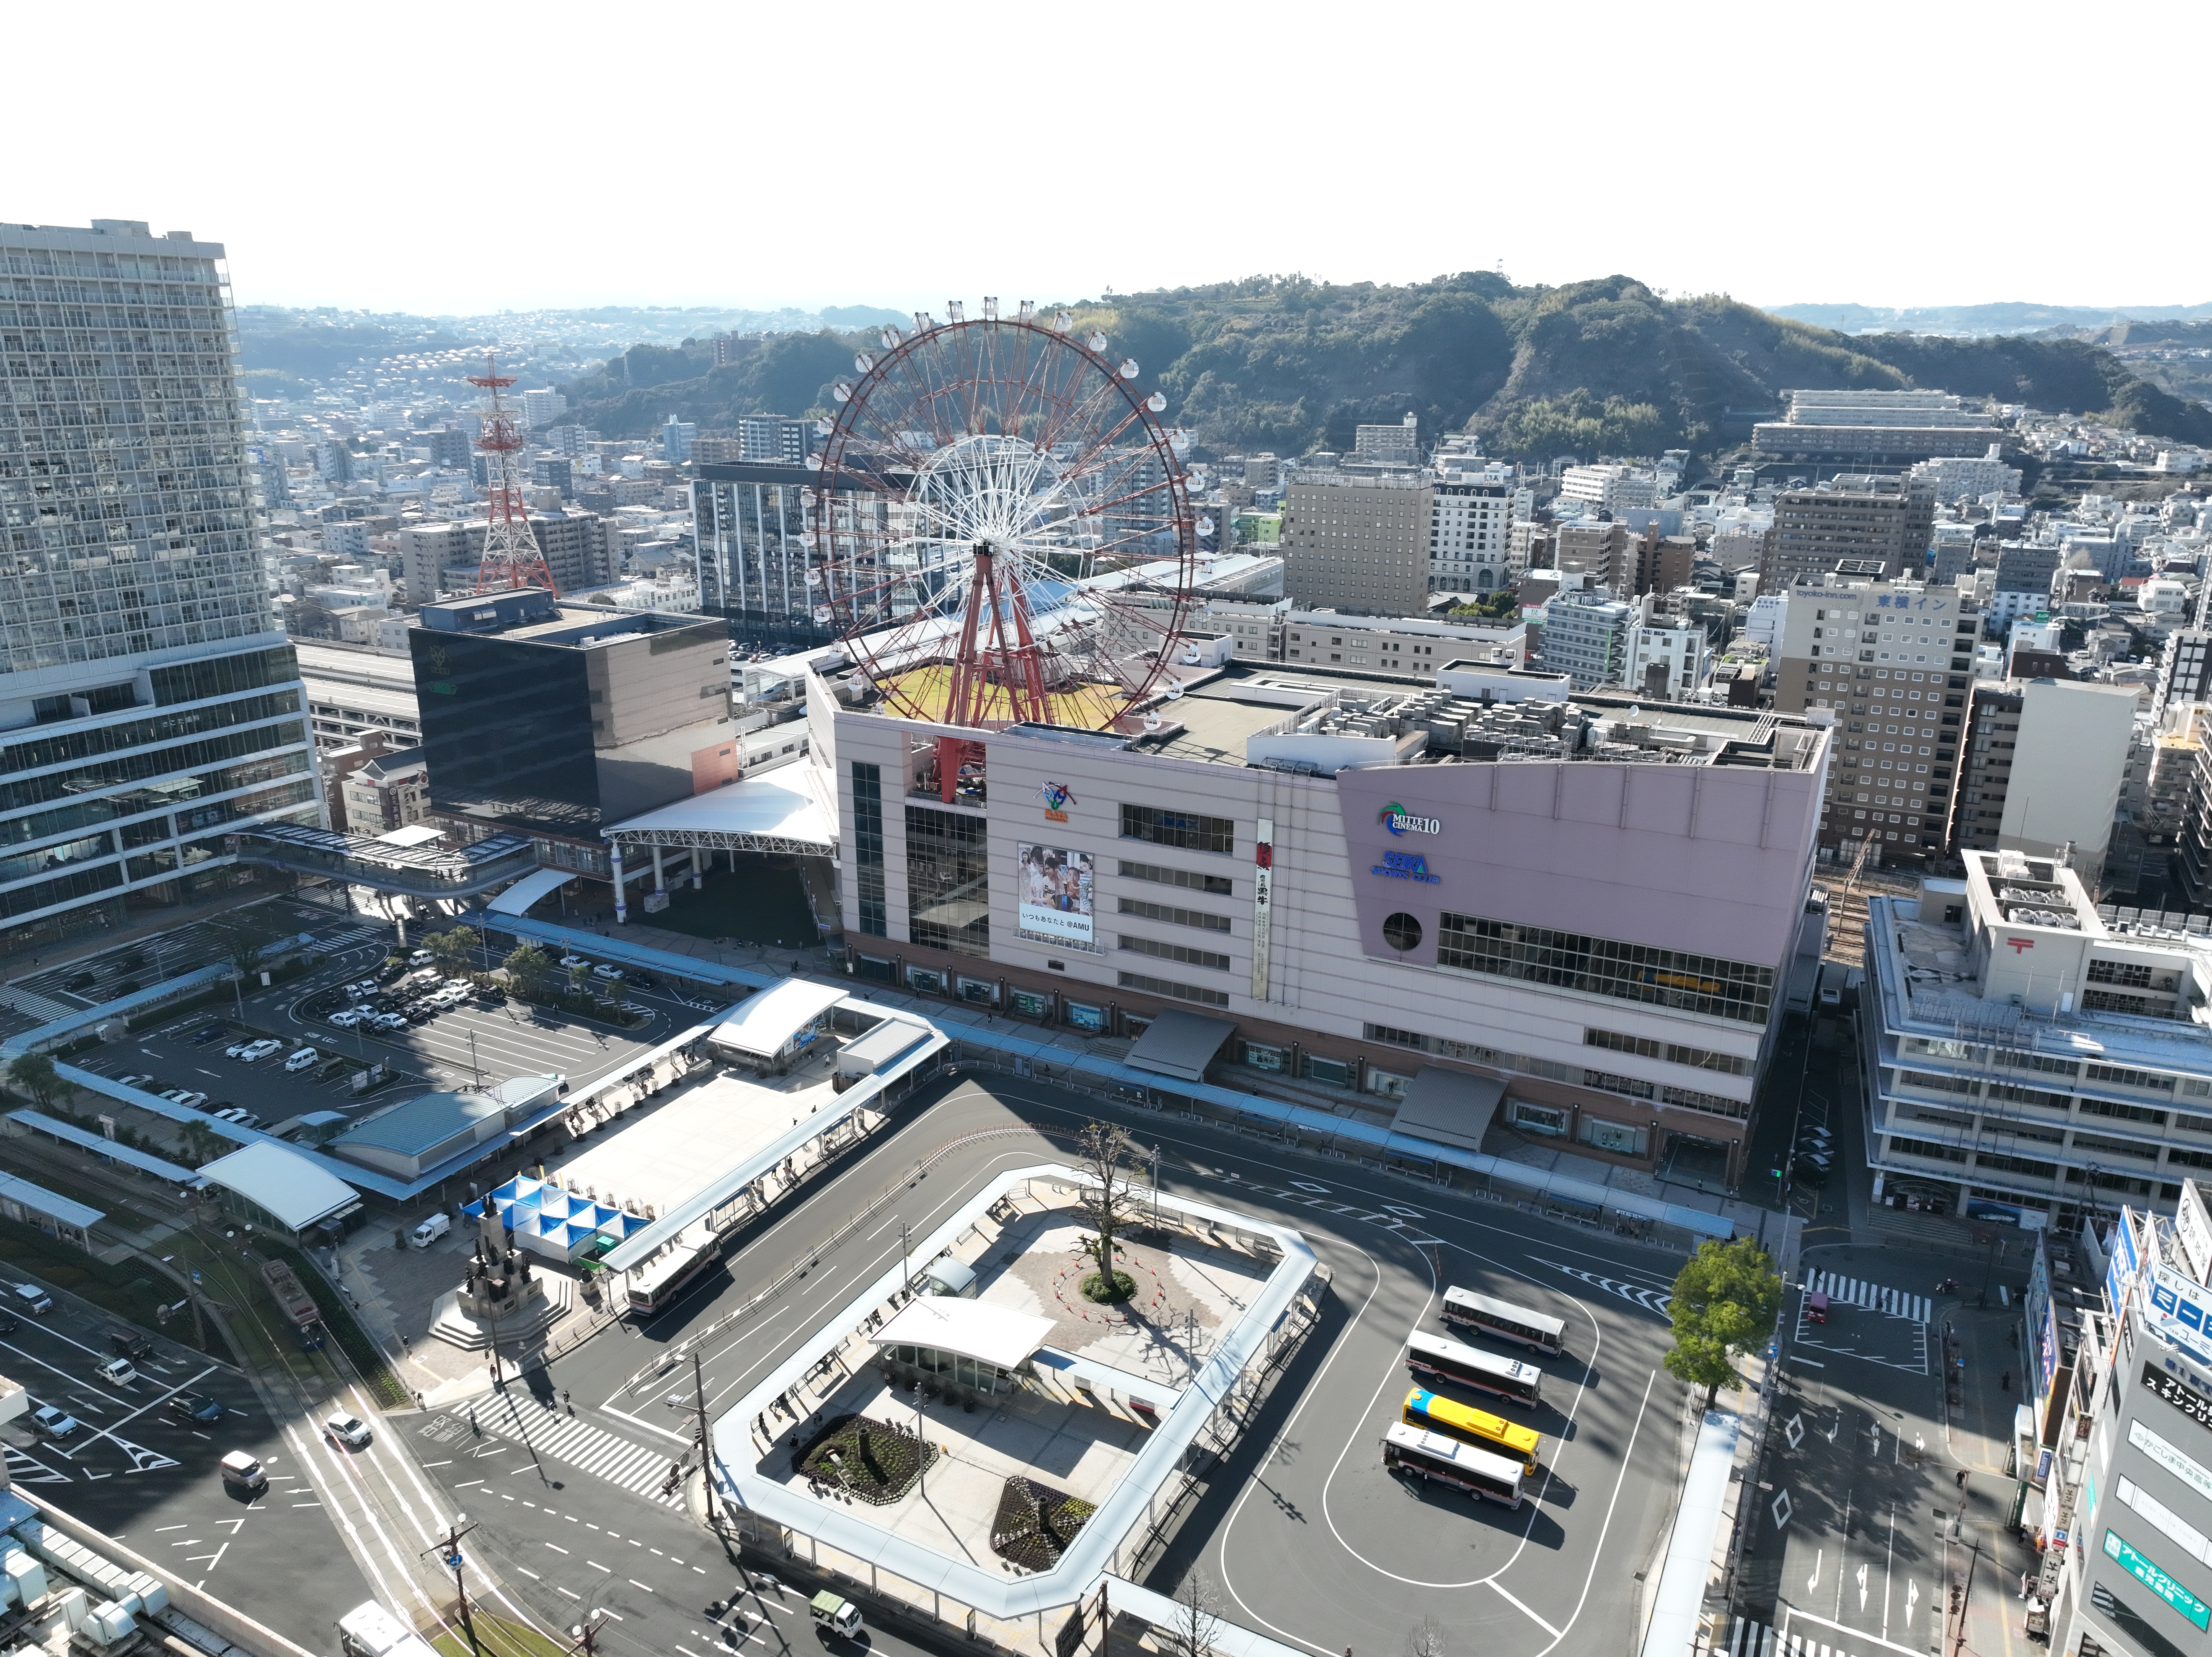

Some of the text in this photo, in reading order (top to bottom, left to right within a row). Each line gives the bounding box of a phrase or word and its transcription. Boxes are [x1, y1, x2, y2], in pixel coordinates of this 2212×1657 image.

[1796, 588, 1857, 600] toyoko-inn.com
[1876, 594, 1947, 611] 東横イン
[162, 715, 200, 728] さこた歯科
[1045, 809, 1067, 819] PLAZA
[1393, 814, 1423, 826] MITTE
[1393, 818, 1440, 834] CINEMA 10
[1382, 851, 1427, 874] SEIKA
[1371, 866, 1440, 885] SPORTS CLUB
[1022, 911, 1090, 932] いつもあなたと @AMU
[2180, 1329, 2212, 1355] ユーミ
[2038, 1452, 2049, 1477] LAWSON
[2122, 1544, 2205, 1613] アトールクリニック
